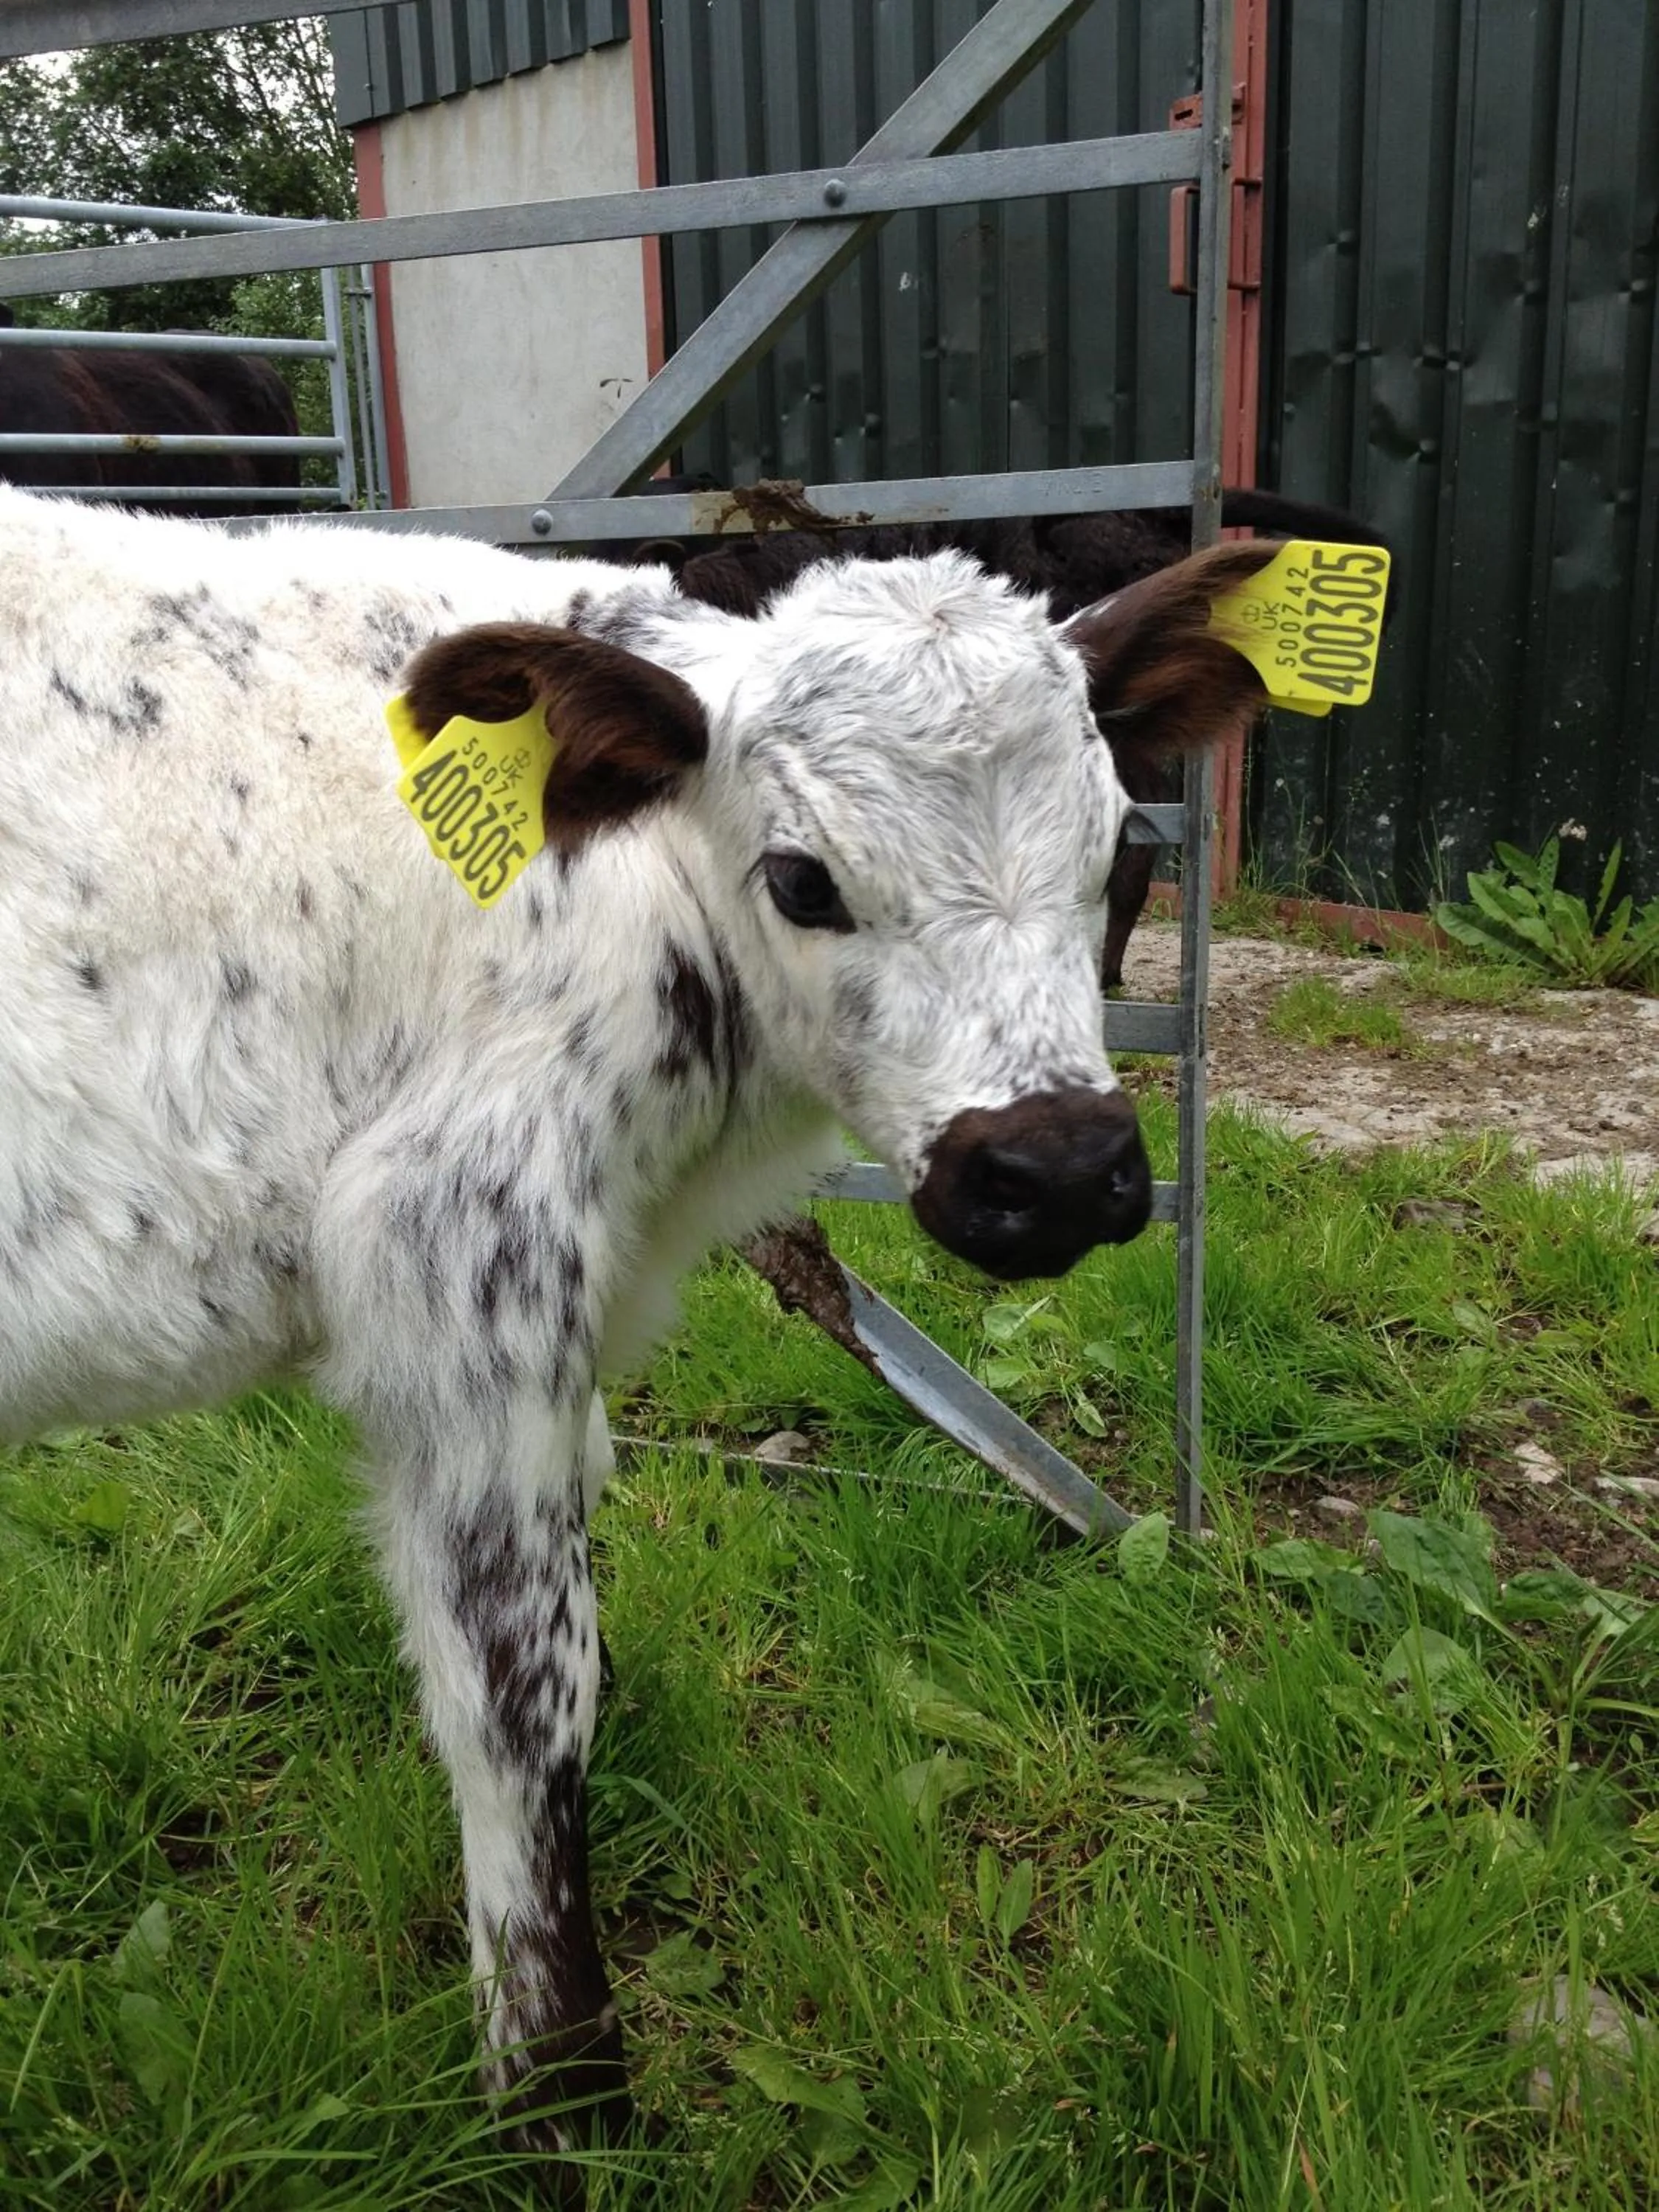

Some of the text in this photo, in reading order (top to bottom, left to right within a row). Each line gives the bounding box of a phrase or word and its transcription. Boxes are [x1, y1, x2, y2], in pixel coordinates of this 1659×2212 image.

[1262, 601, 1281, 630] UK
[1297, 549, 1385, 696] 400305
[499, 755, 524, 788] UK
[411, 749, 526, 900] 400305
